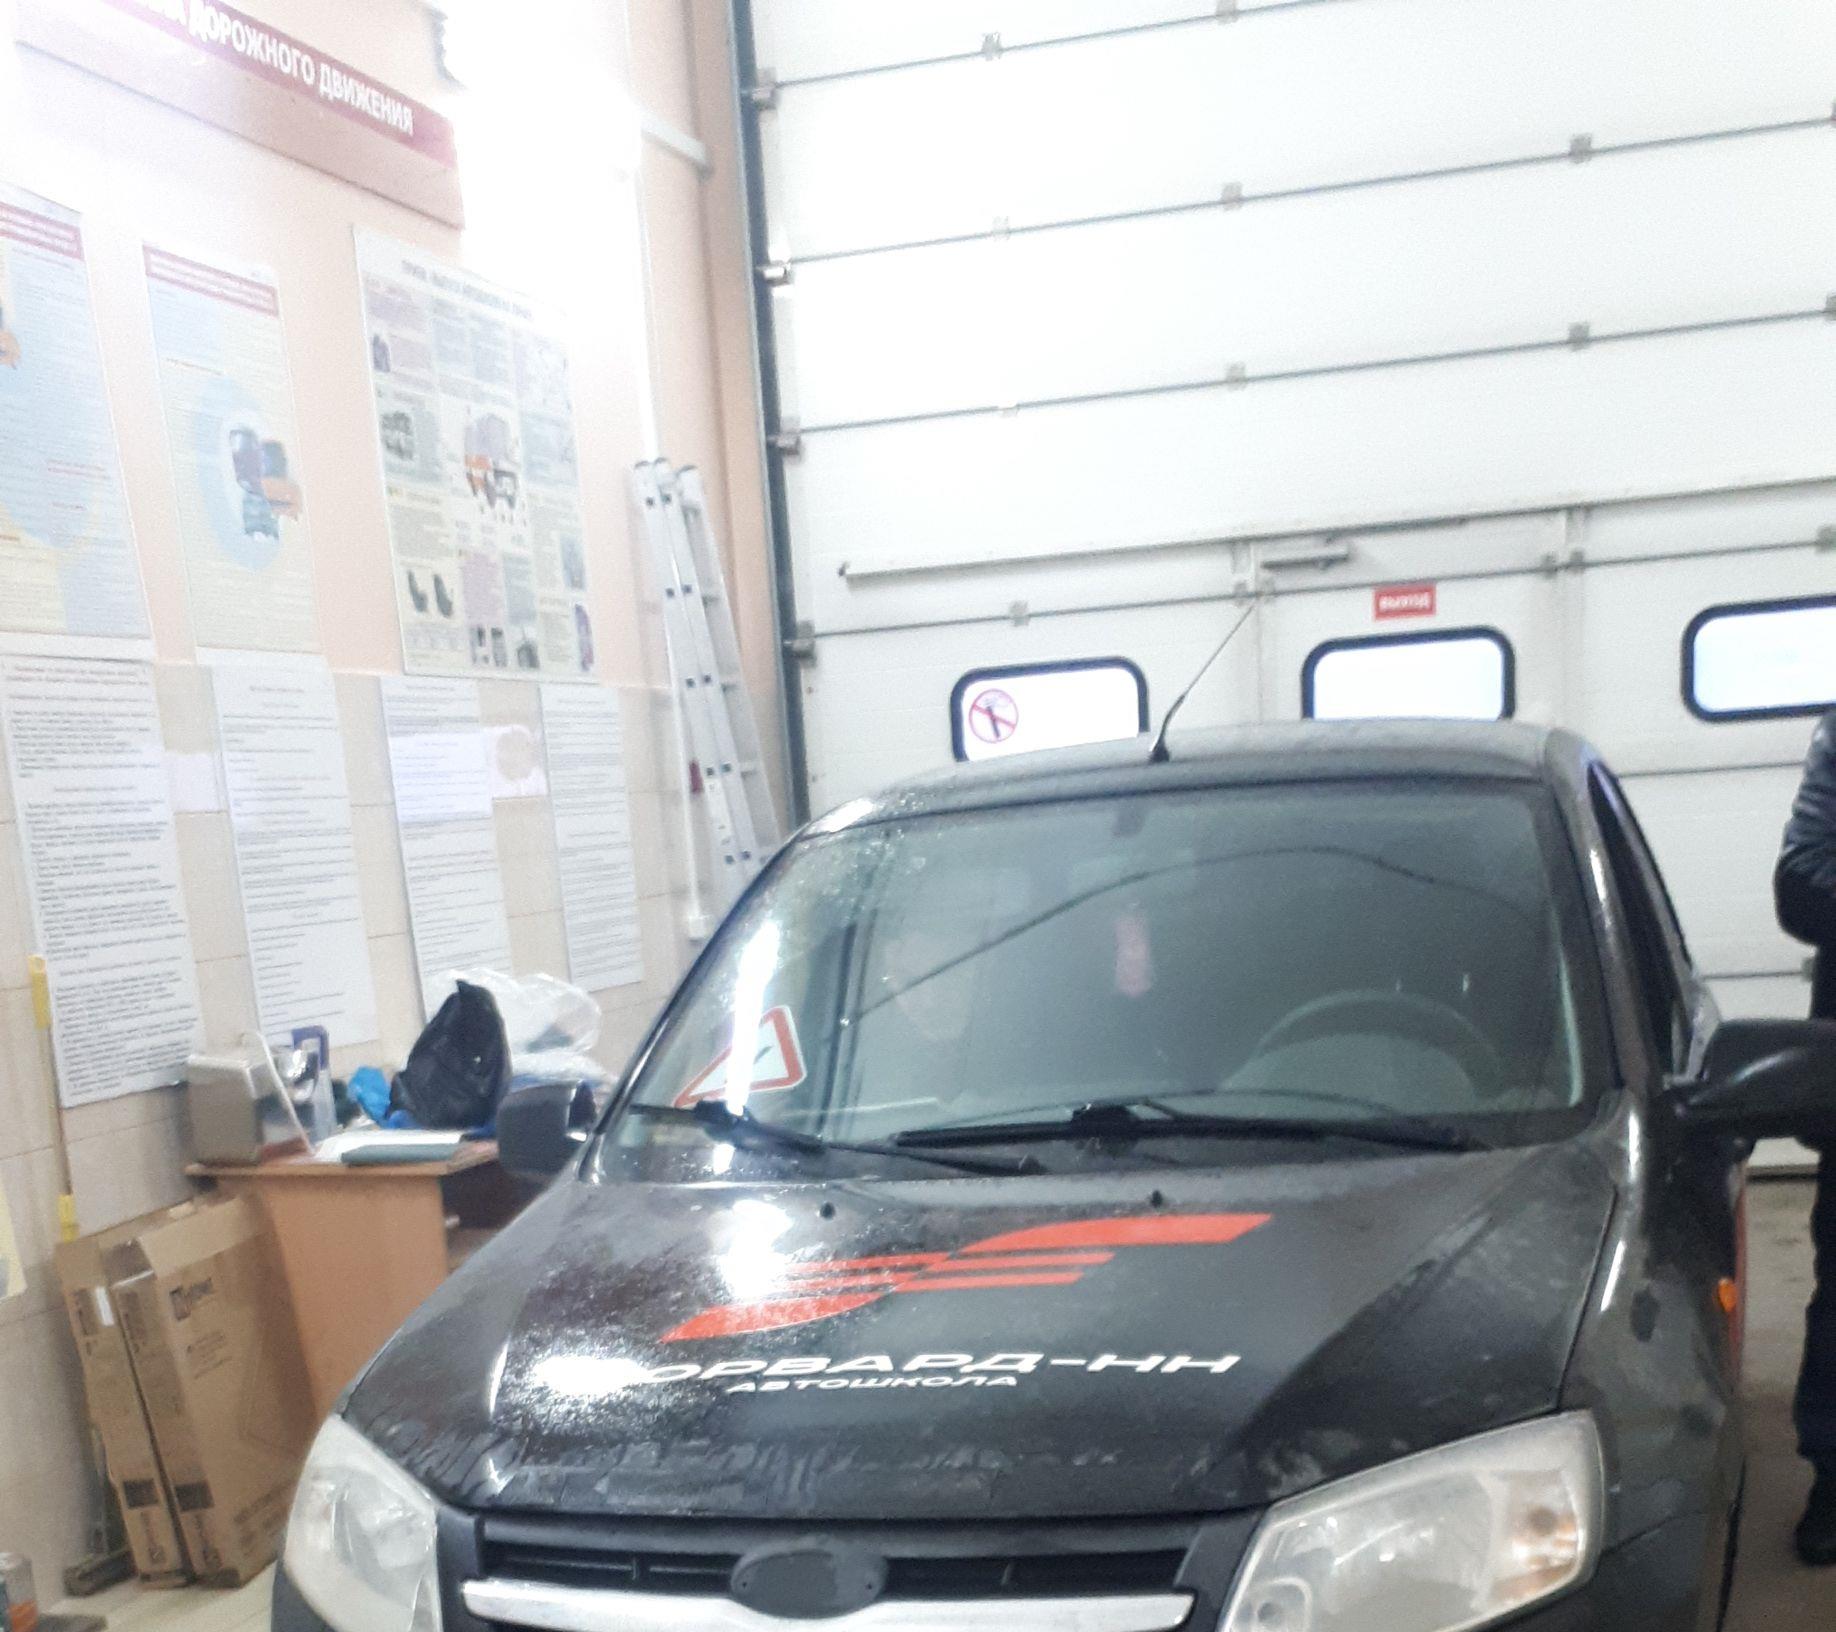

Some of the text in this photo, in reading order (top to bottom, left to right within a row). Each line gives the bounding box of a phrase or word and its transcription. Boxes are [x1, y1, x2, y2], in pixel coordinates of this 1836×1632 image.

[189, 0, 415, 136] ДОРОЖНОГО ДВИЖЕНИЯ
[575, 1353, 1241, 1386] ОРВАРД-НН
[726, 1375, 1018, 1394] АВТОШКОЛА
